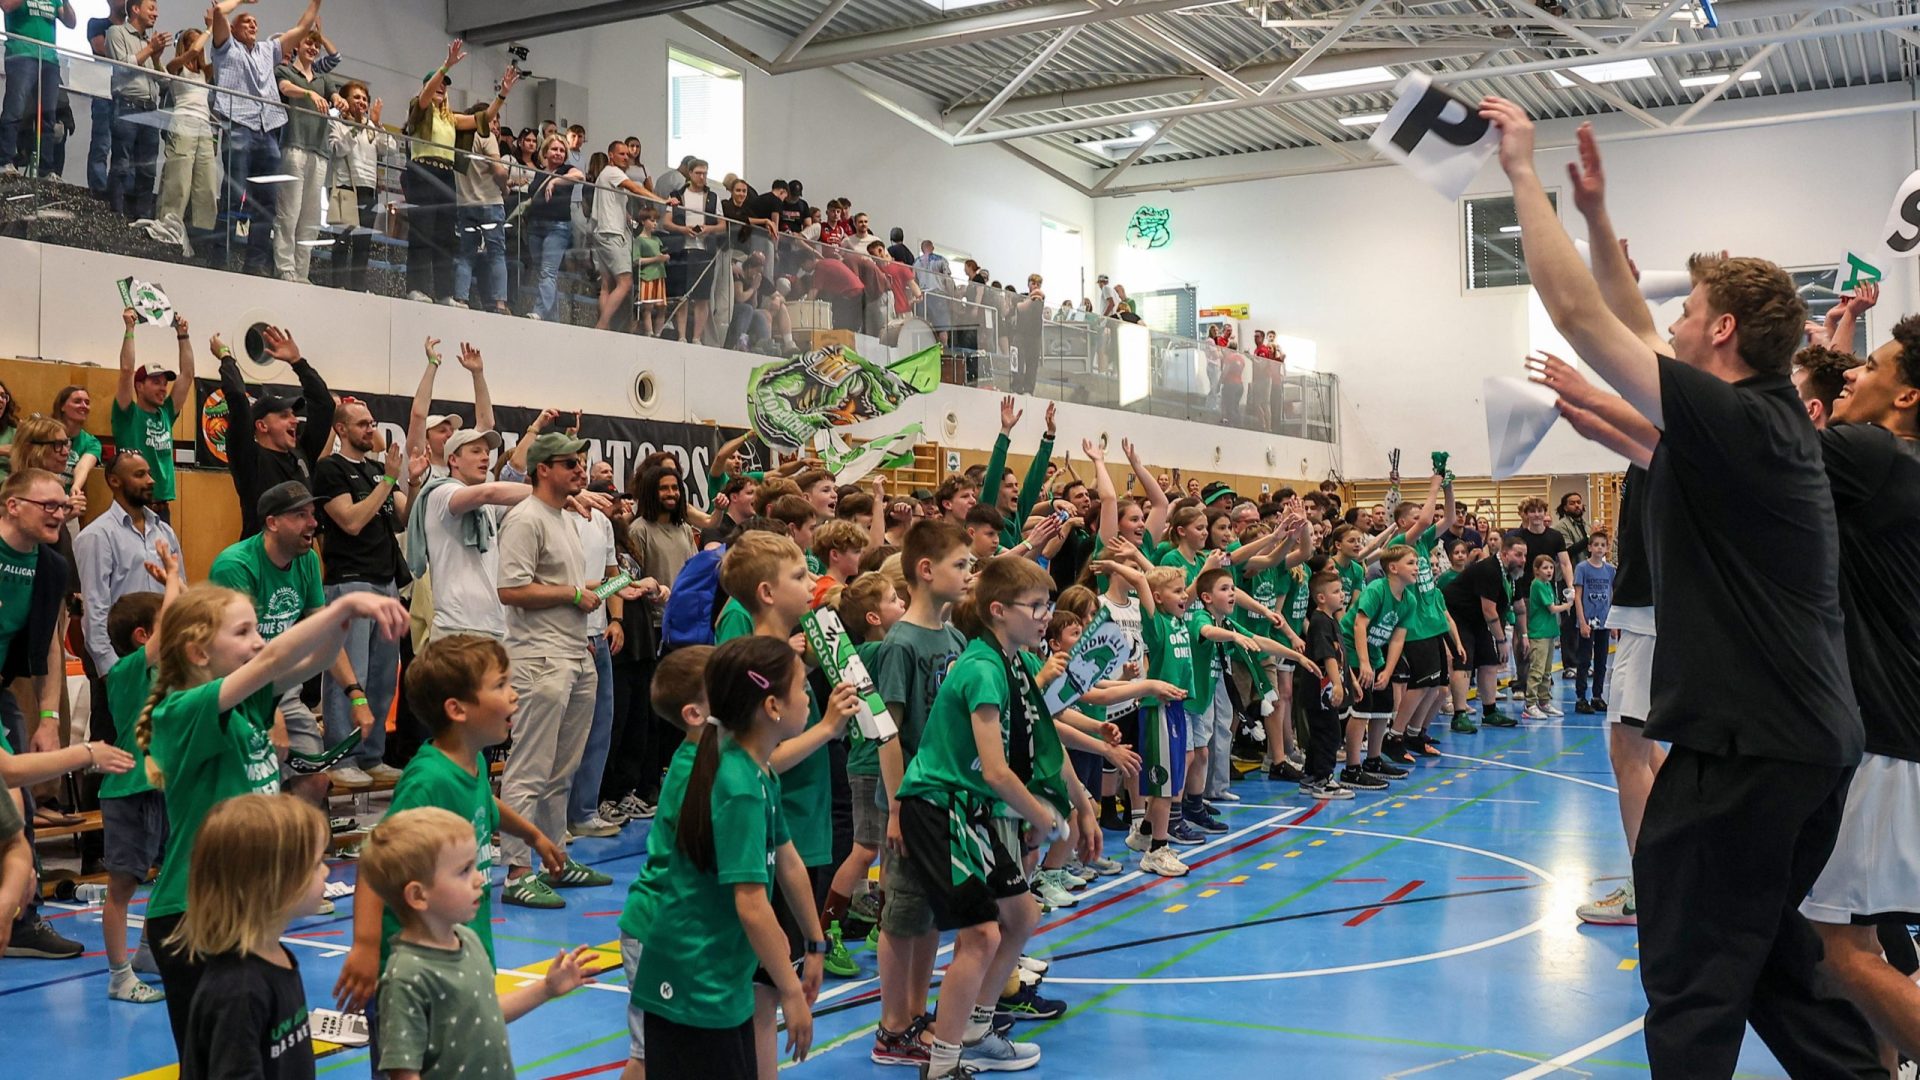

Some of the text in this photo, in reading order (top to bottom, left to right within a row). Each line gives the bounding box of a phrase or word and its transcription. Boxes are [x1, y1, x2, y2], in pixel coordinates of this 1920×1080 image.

[1390, 85, 1490, 154] P
[1886, 189, 1920, 252] S
[1841, 252, 1882, 291] A
[4, 564, 36, 577] ALLIGAT
